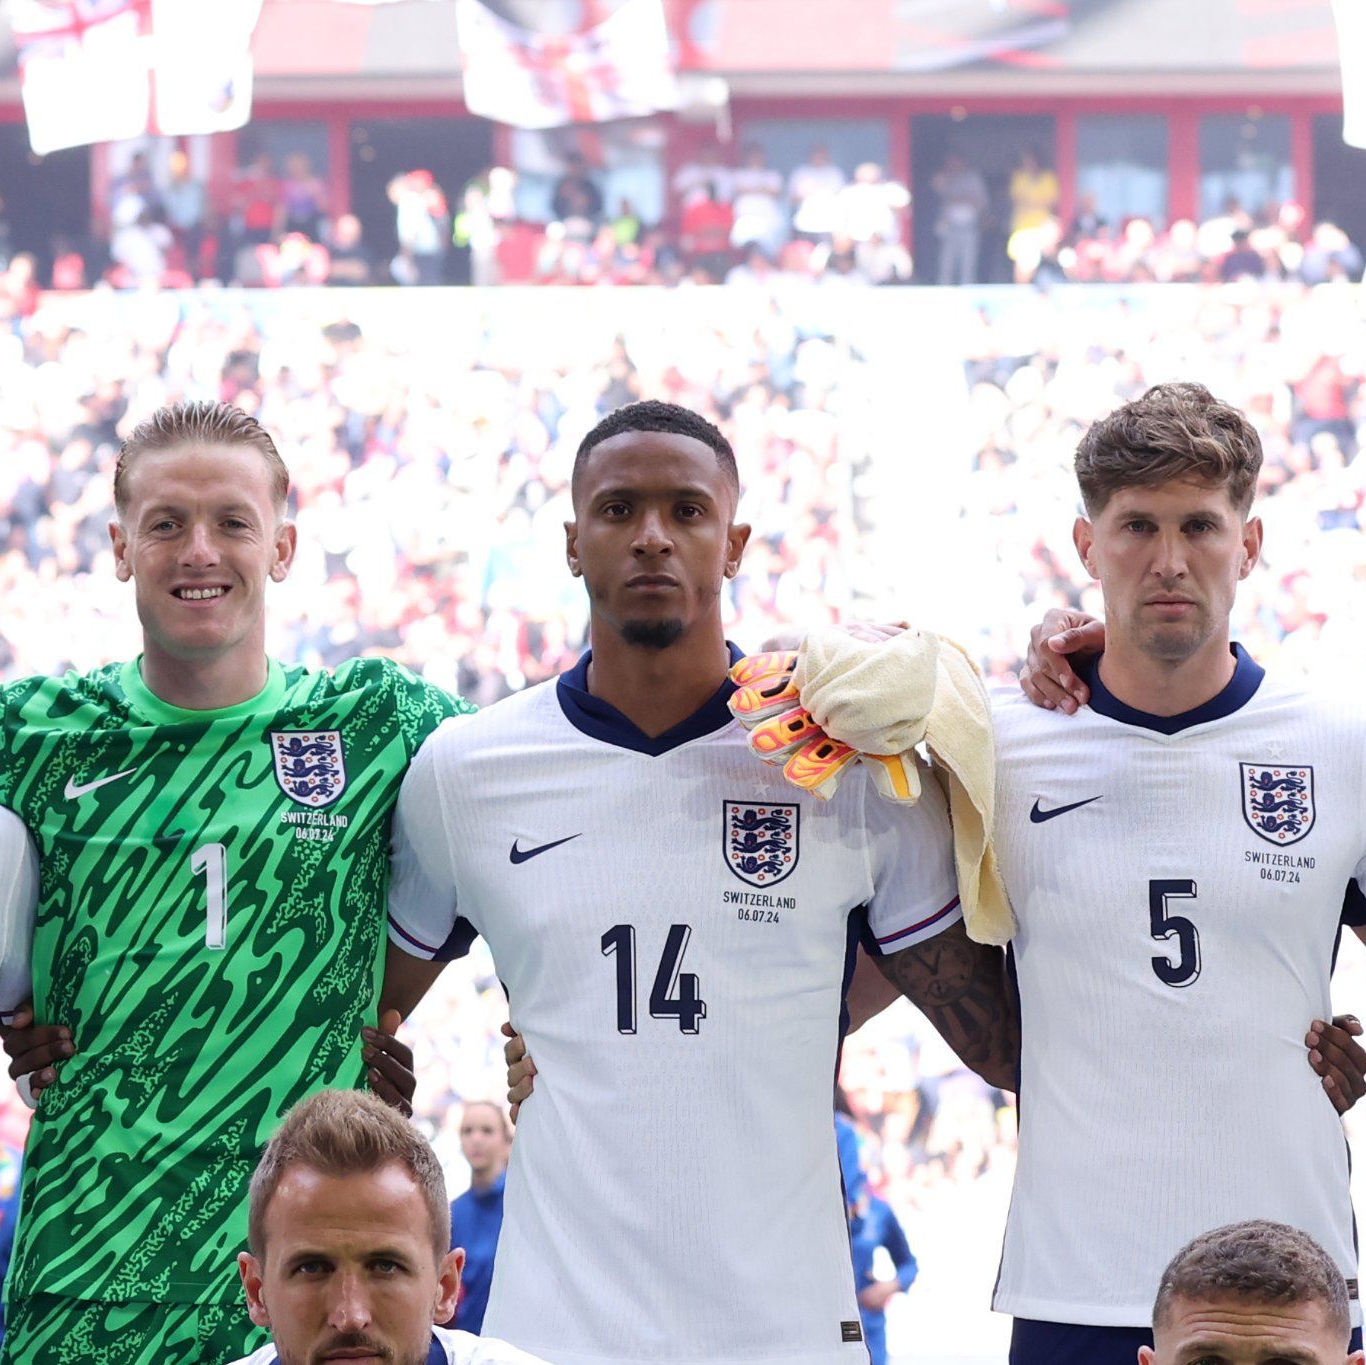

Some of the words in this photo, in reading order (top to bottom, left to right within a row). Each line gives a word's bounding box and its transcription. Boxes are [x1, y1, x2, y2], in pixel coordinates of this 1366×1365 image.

[280, 811, 348, 827] SWITZERLAND
[296, 827, 334, 842] 06.07.24
[1245, 851, 1316, 869] SWITZERLAND
[1260, 868, 1300, 883] 06.07.24
[190, 842, 228, 950] 1
[723, 891, 796, 910] SWITZERLAND
[737, 908, 779, 923] 06.07.24
[1149, 879, 1202, 988] 5
[601, 924, 706, 1034] 14
